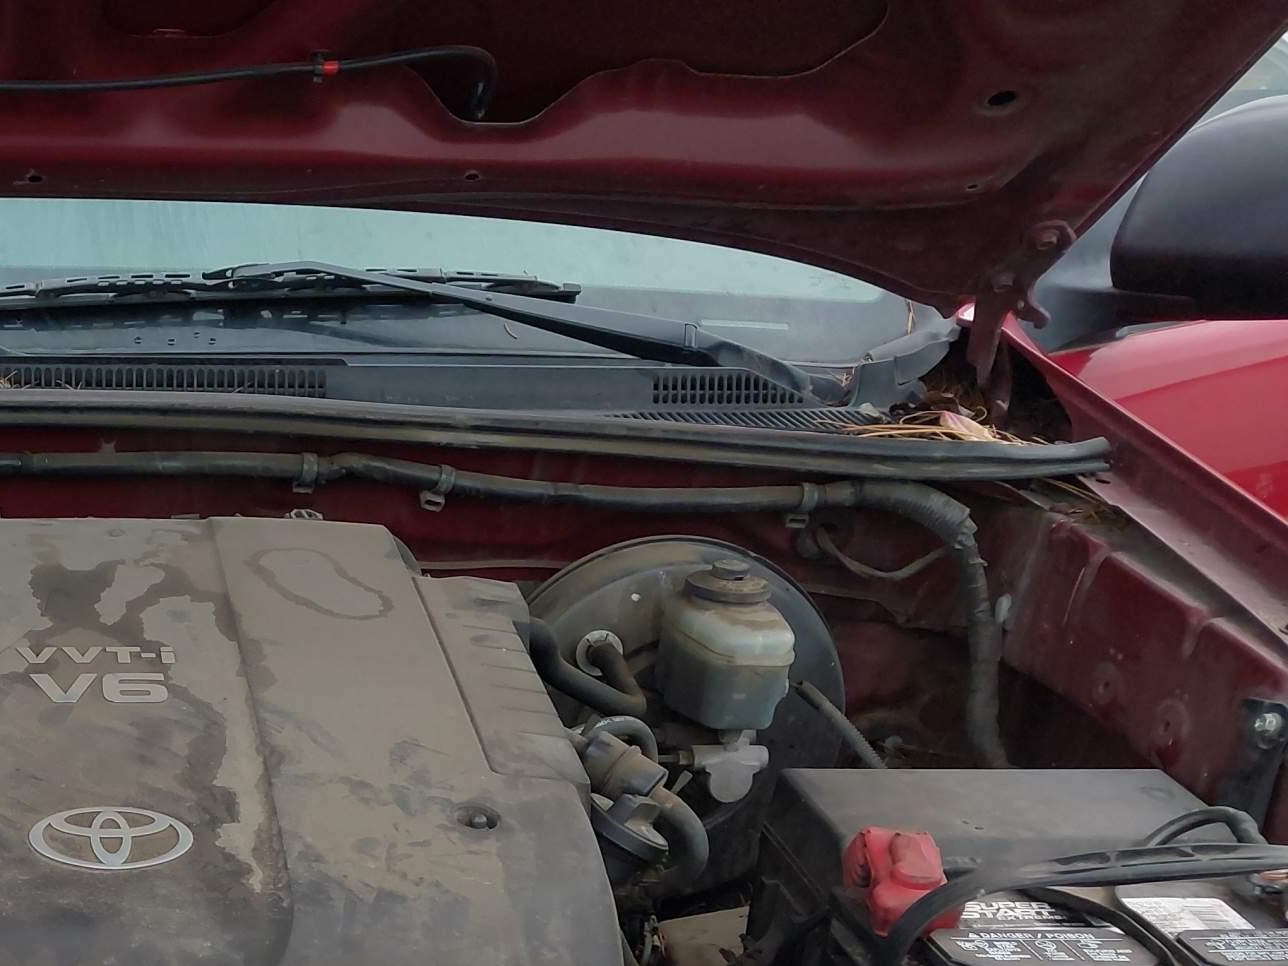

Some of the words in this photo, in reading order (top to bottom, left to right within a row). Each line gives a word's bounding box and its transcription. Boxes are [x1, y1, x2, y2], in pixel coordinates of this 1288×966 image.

[16, 646, 176, 664] VVT-i
[29, 672, 169, 703] V6
[964, 901, 1054, 911] SUPER
[961, 909, 1053, 919] START
